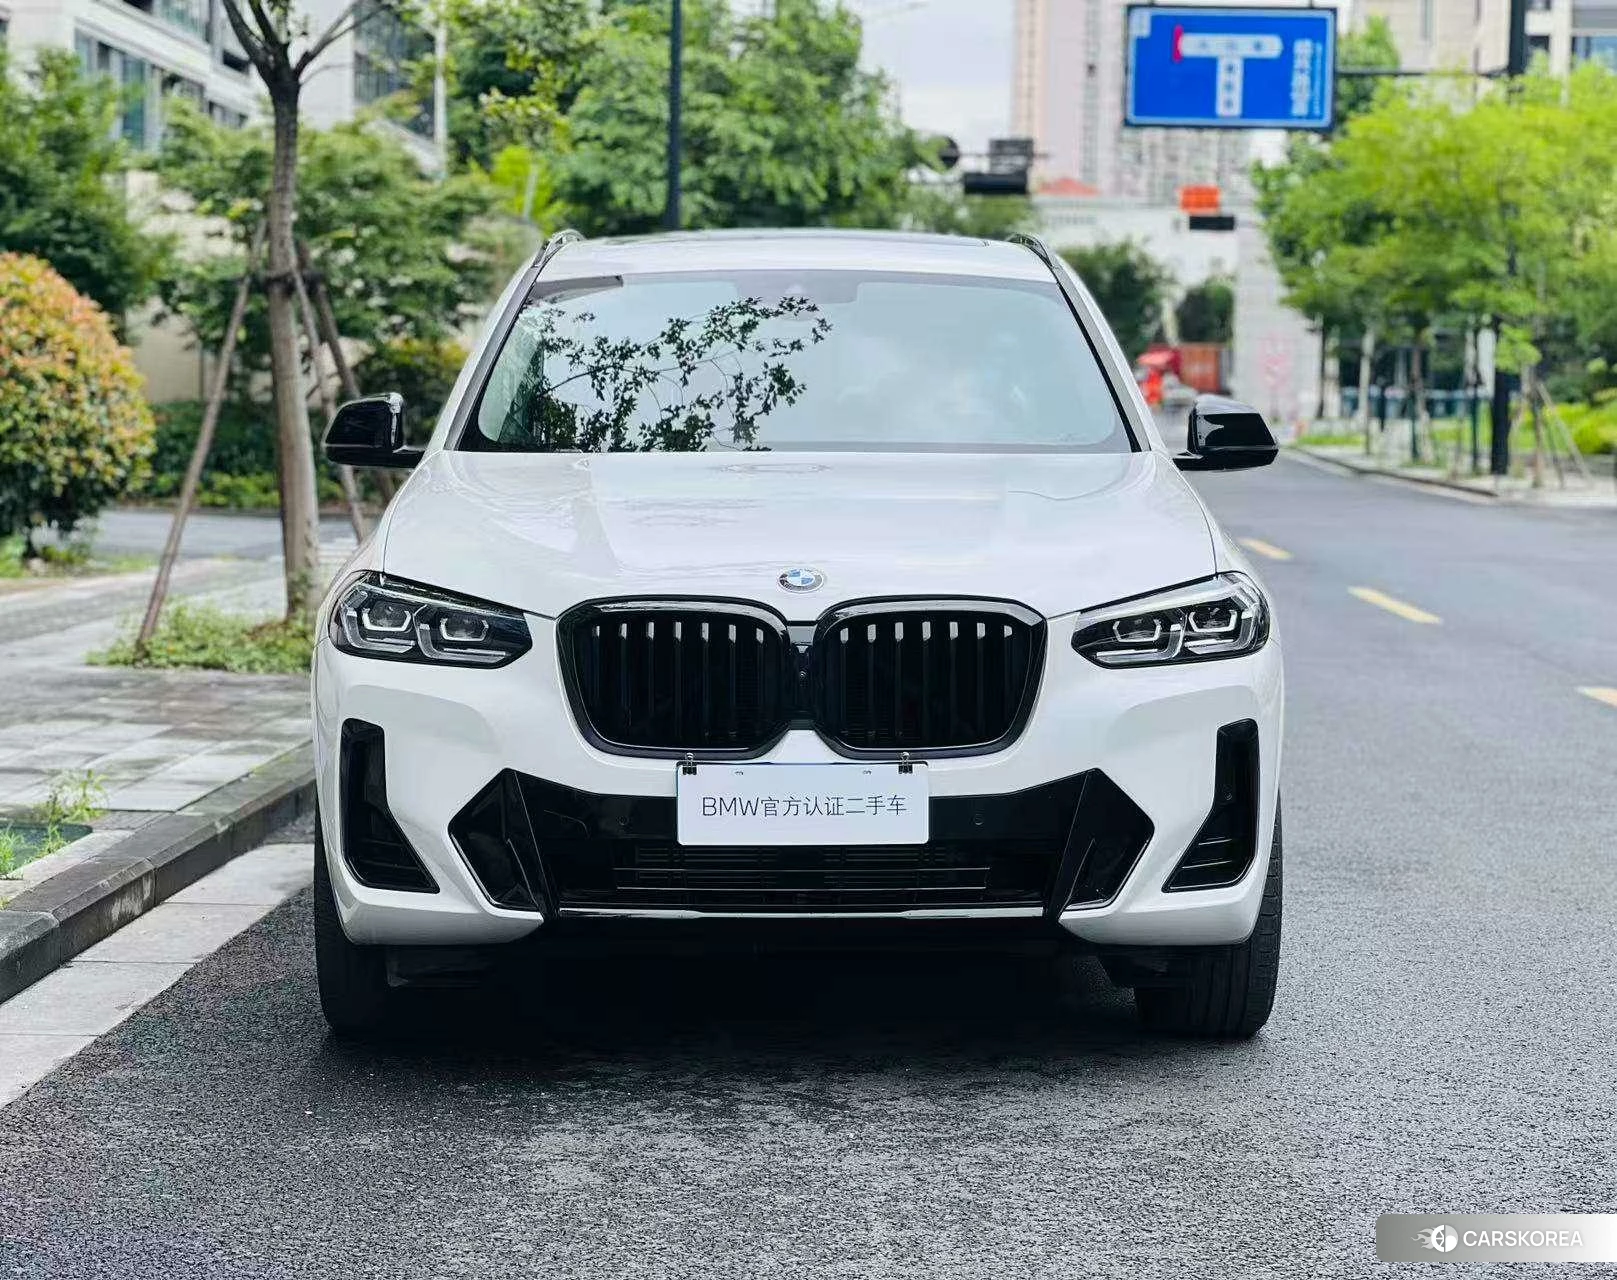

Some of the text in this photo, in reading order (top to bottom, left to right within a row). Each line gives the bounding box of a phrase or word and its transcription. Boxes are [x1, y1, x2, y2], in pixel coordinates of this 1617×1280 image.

[702, 794, 907, 817] BMW官方认证二手车
